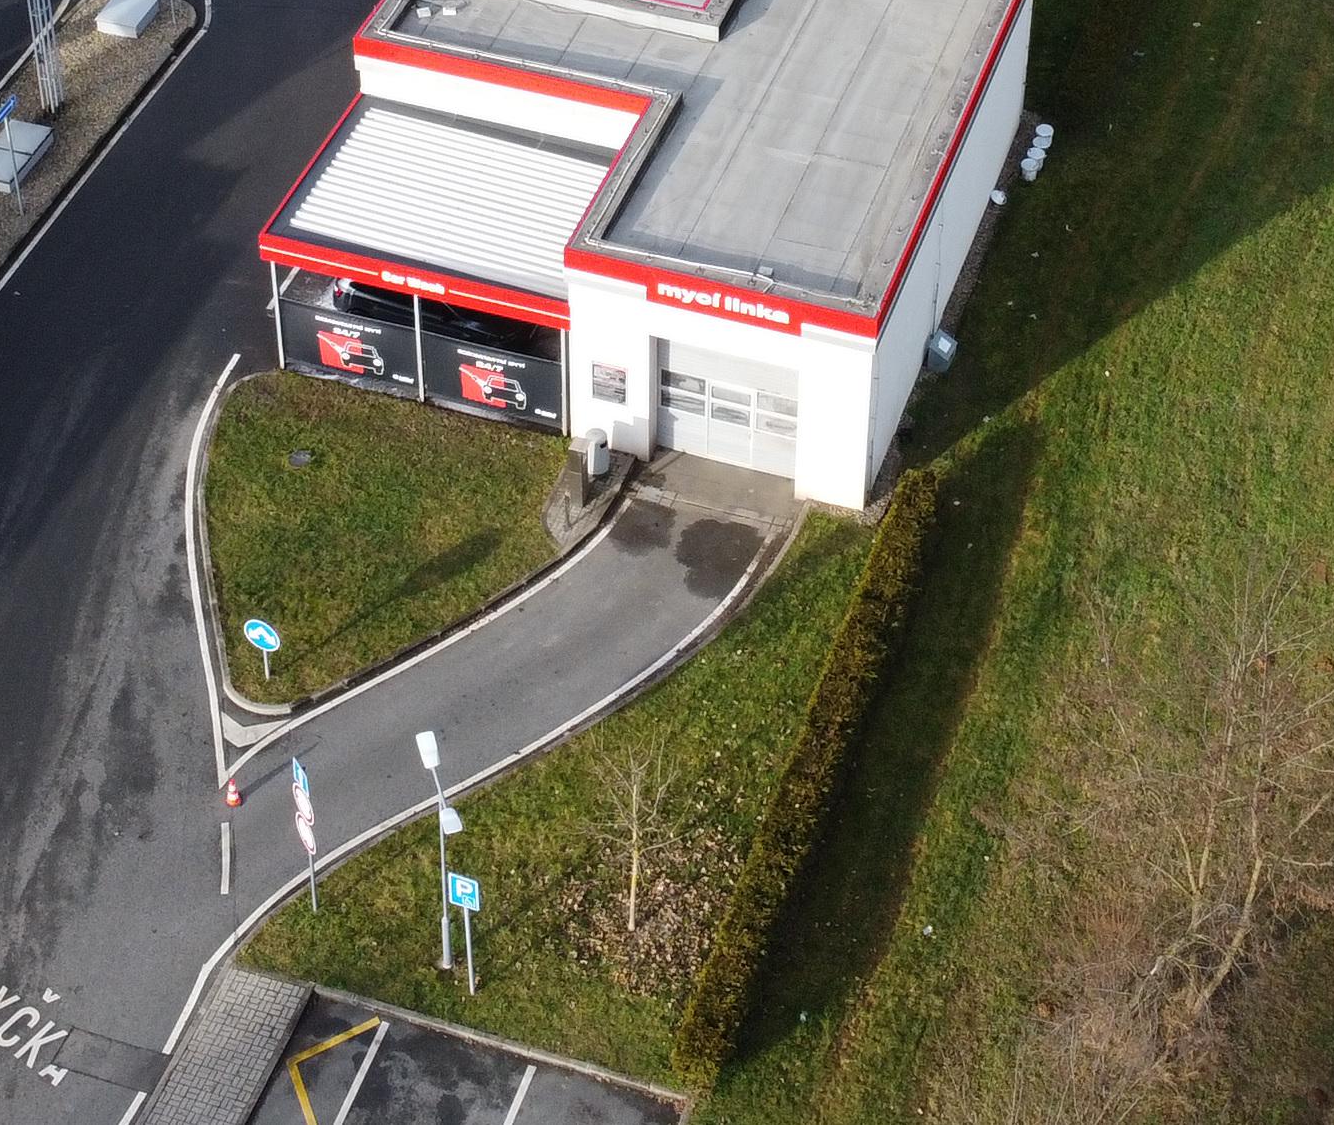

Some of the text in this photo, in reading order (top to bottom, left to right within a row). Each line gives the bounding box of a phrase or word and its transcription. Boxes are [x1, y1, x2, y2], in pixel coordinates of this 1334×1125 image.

[380, 271, 406, 286] Car
[724, 296, 790, 325] linka
[455, 879, 473, 897] P
